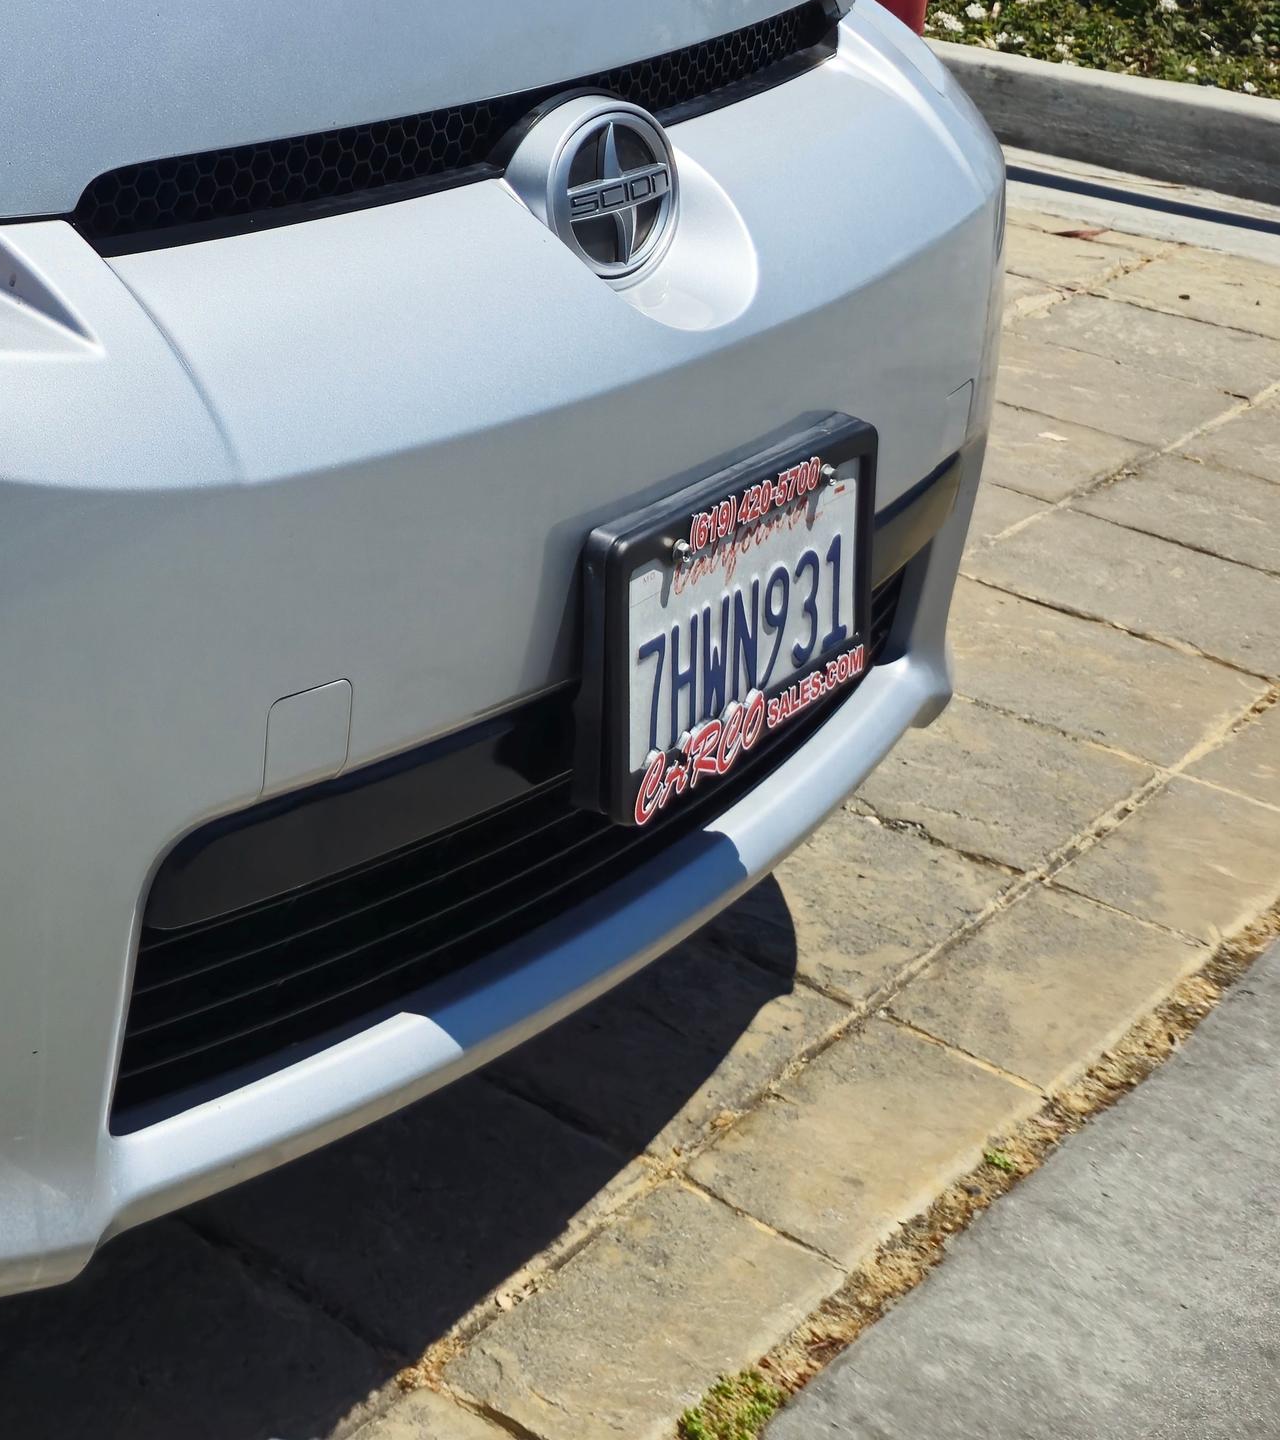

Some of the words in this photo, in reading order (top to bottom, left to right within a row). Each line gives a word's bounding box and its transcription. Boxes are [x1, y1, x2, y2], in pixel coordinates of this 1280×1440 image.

[690, 494, 738, 554] (619)
[737, 456, 821, 525] 420-5700
[639, 533, 848, 751] 7HWN931
[634, 689, 765, 826] CARCO
[766, 644, 865, 729] SALES.COM
